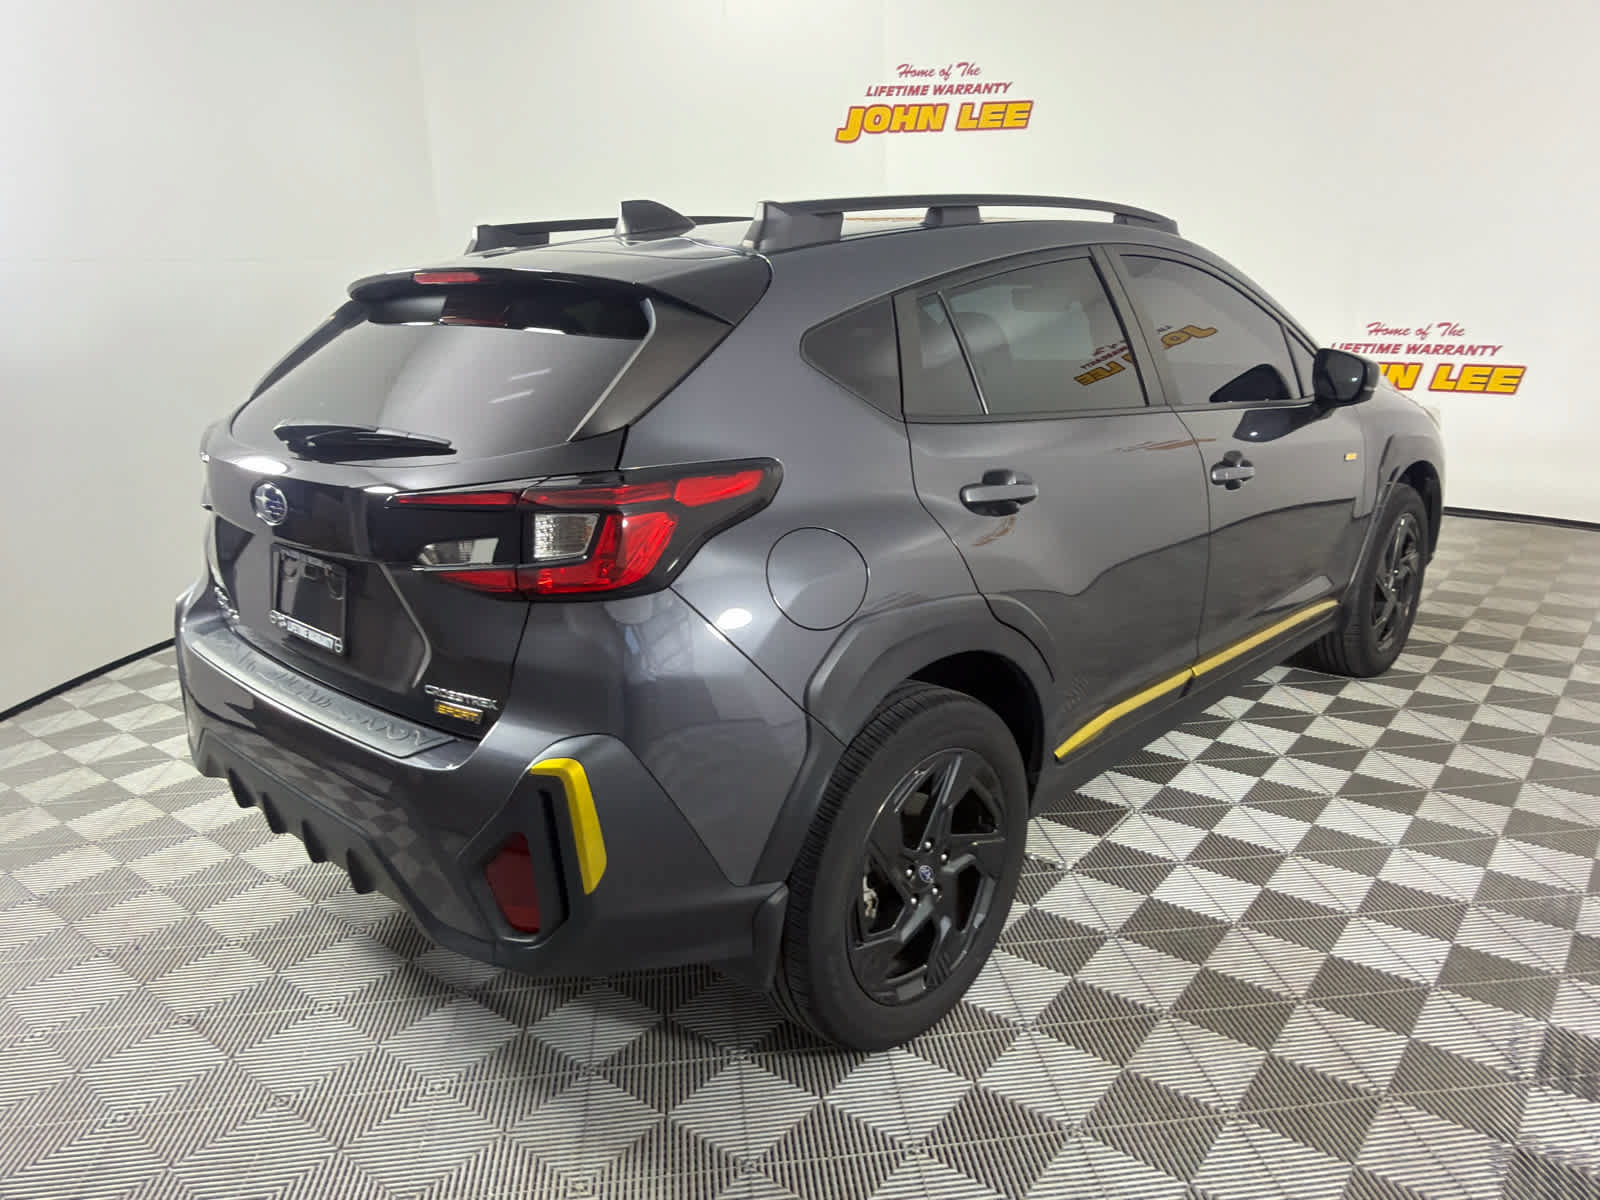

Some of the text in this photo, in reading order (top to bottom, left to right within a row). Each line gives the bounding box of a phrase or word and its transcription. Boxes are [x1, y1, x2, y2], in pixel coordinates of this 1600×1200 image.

[896, 62, 980, 80] Home of The
[865, 81, 1013, 97] LIFETIME WARRANTY
[835, 100, 1033, 143] JOHN LEE
[1366, 321, 1465, 340] Home of The
[1404, 343, 1503, 357] WARRANTY
[1428, 363, 1526, 395] LEE
[424, 684, 498, 710] CROSSTREK
